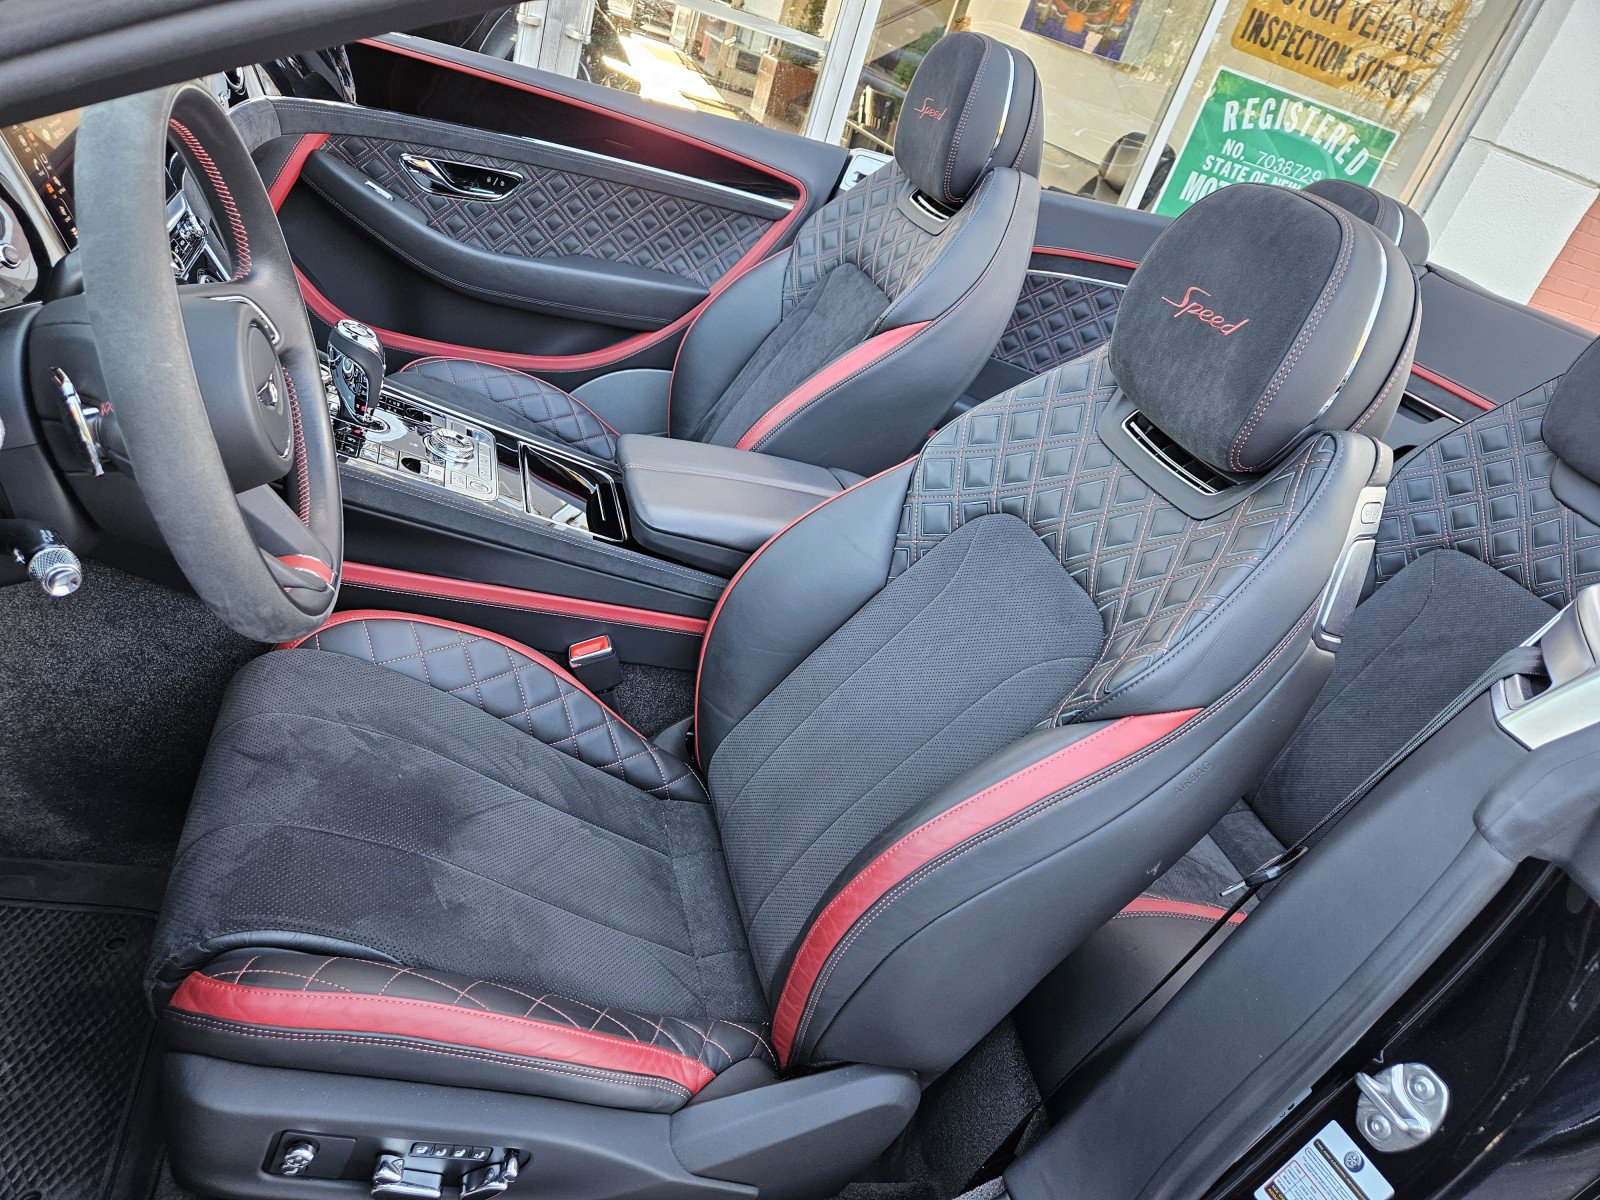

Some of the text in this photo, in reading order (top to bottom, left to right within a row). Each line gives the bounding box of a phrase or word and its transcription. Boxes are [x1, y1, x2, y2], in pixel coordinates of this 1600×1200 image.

[1240, 8, 1353, 76] INSPECTION
[1348, 0, 1443, 62] VEHICLE
[913, 97, 948, 121] Speed
[1223, 97, 1370, 176] REGISTERED
[1202, 154, 1251, 184] STATE
[1221, 138, 1322, 184] NO. 7038729
[1179, 171, 1233, 203] MO
[1161, 286, 1250, 335] Speed
[1174, 761, 1212, 794] AIRBAG
